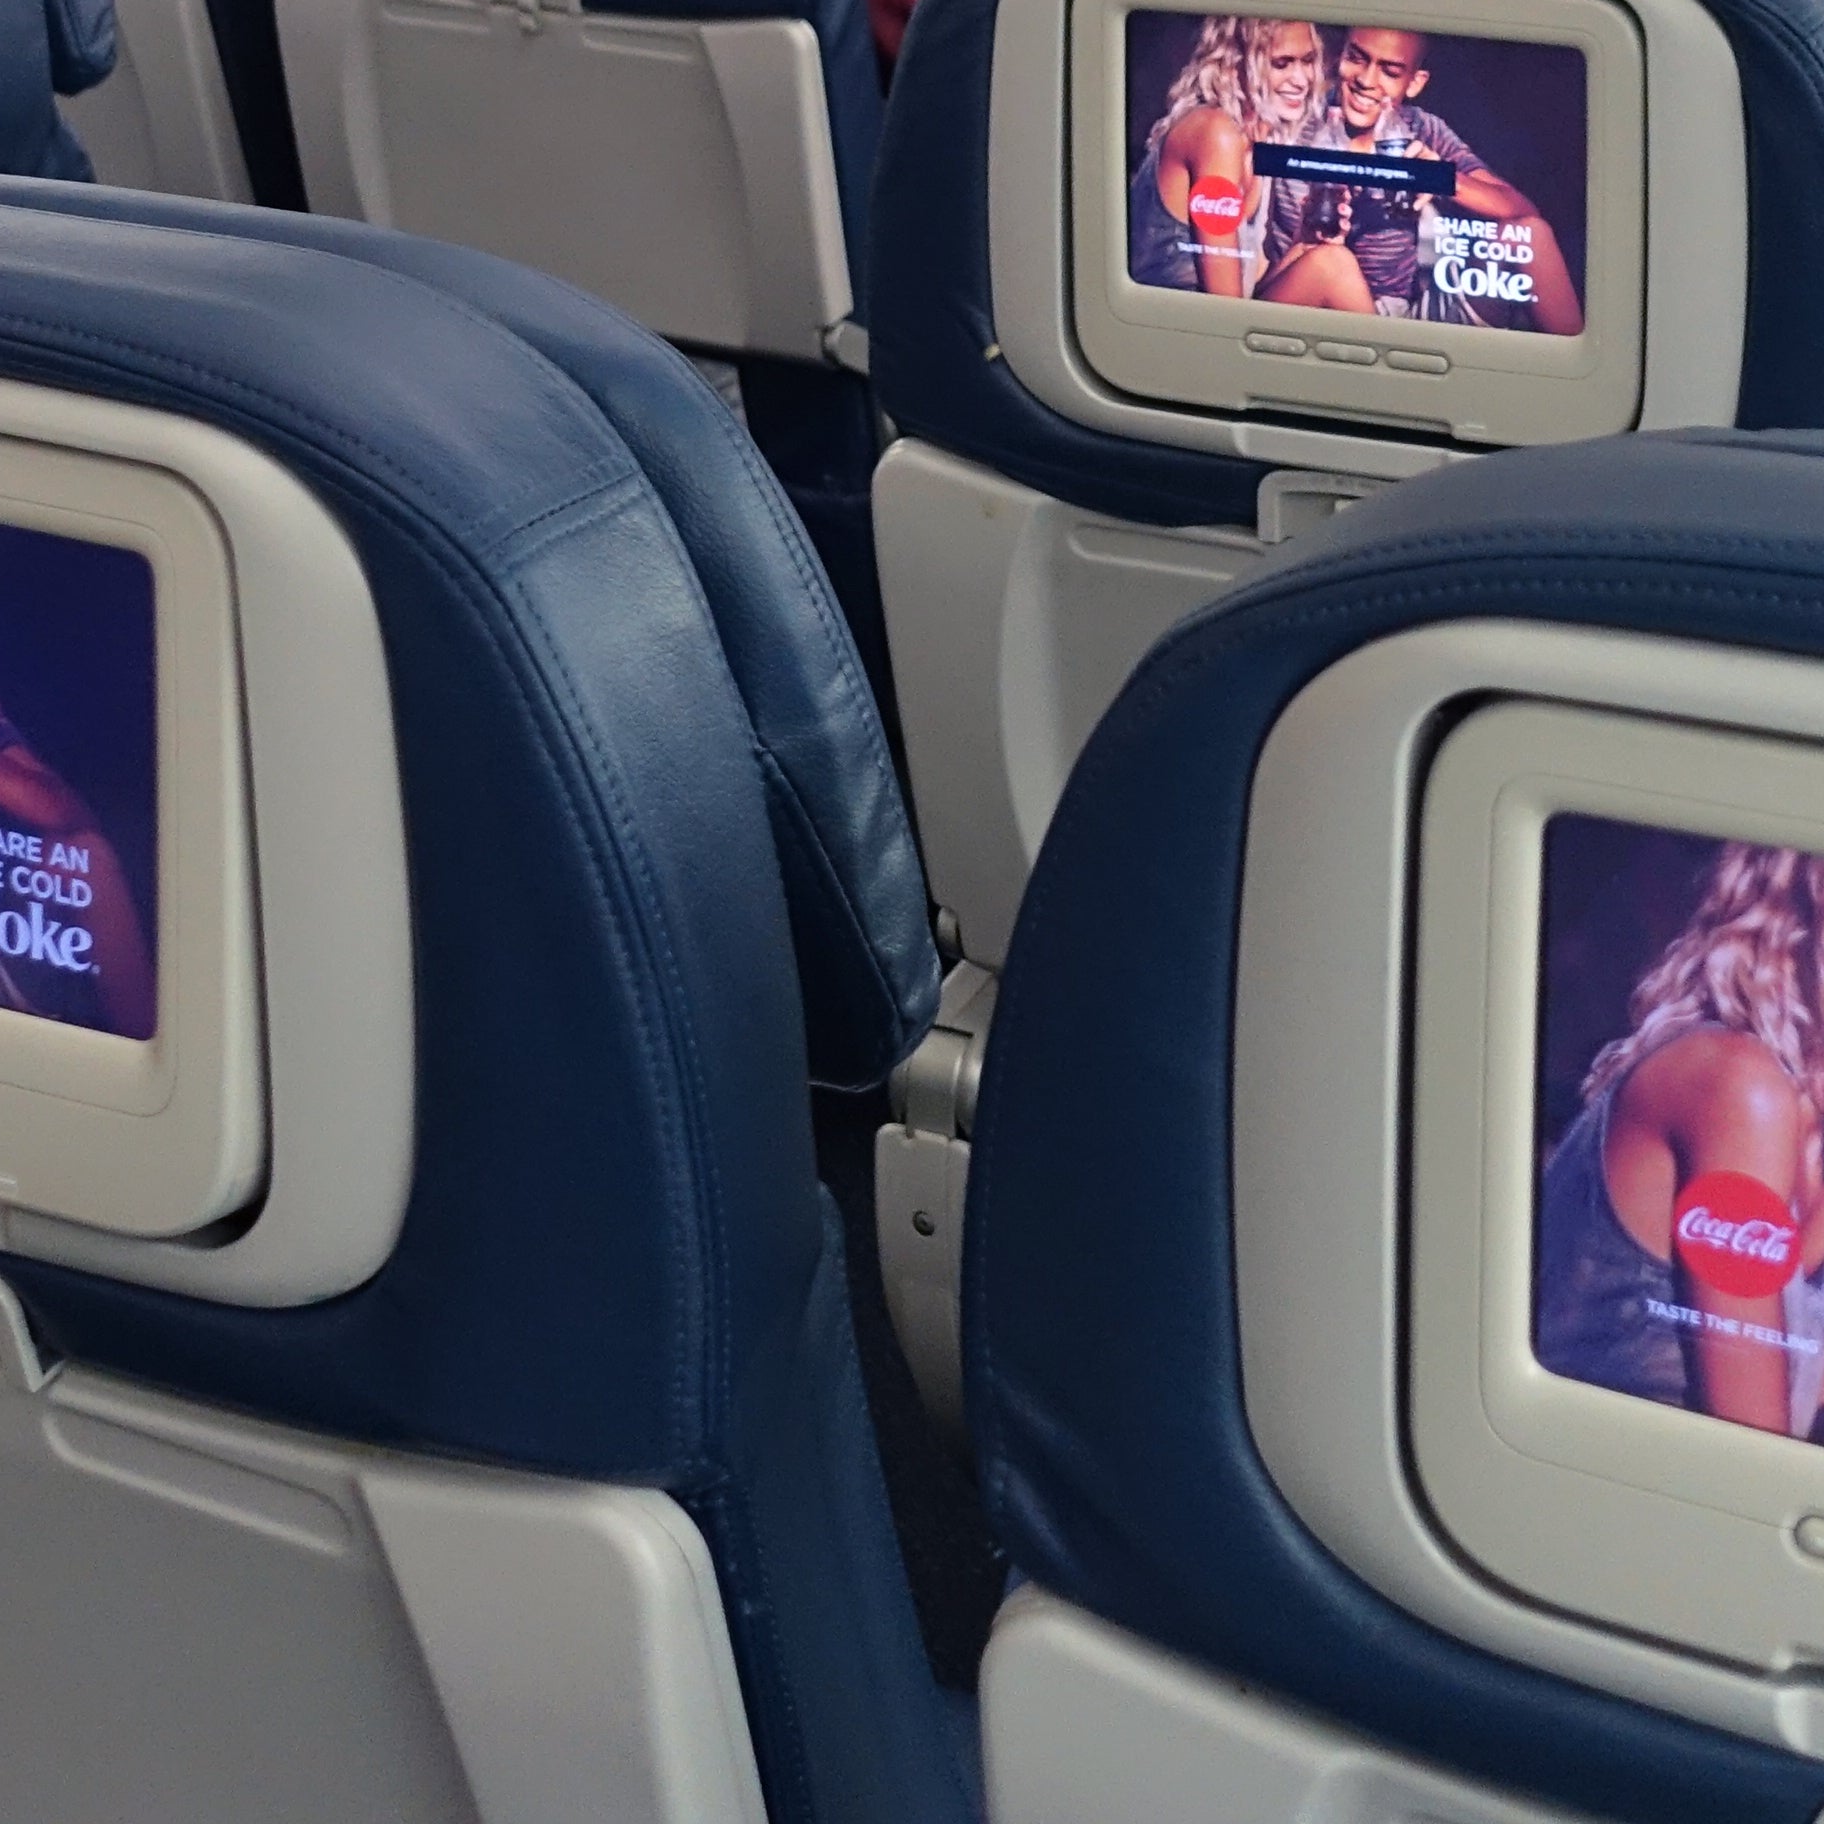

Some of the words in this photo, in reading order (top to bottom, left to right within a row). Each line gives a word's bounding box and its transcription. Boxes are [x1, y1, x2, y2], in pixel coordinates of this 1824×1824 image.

[1433, 216, 1498, 240] SHARE
[1501, 224, 1532, 244] AN
[1434, 236, 1470, 257] ICE
[1473, 240, 1534, 264] COLD
[49, 842, 89, 873] AN
[11, 866, 93, 908] COLD
[1678, 1206, 1794, 1263] Coca-Cola
[1646, 1298, 1703, 1326] TASTE
[1704, 1312, 1741, 1337] THE
[1742, 1322, 1820, 1355] FEELING
